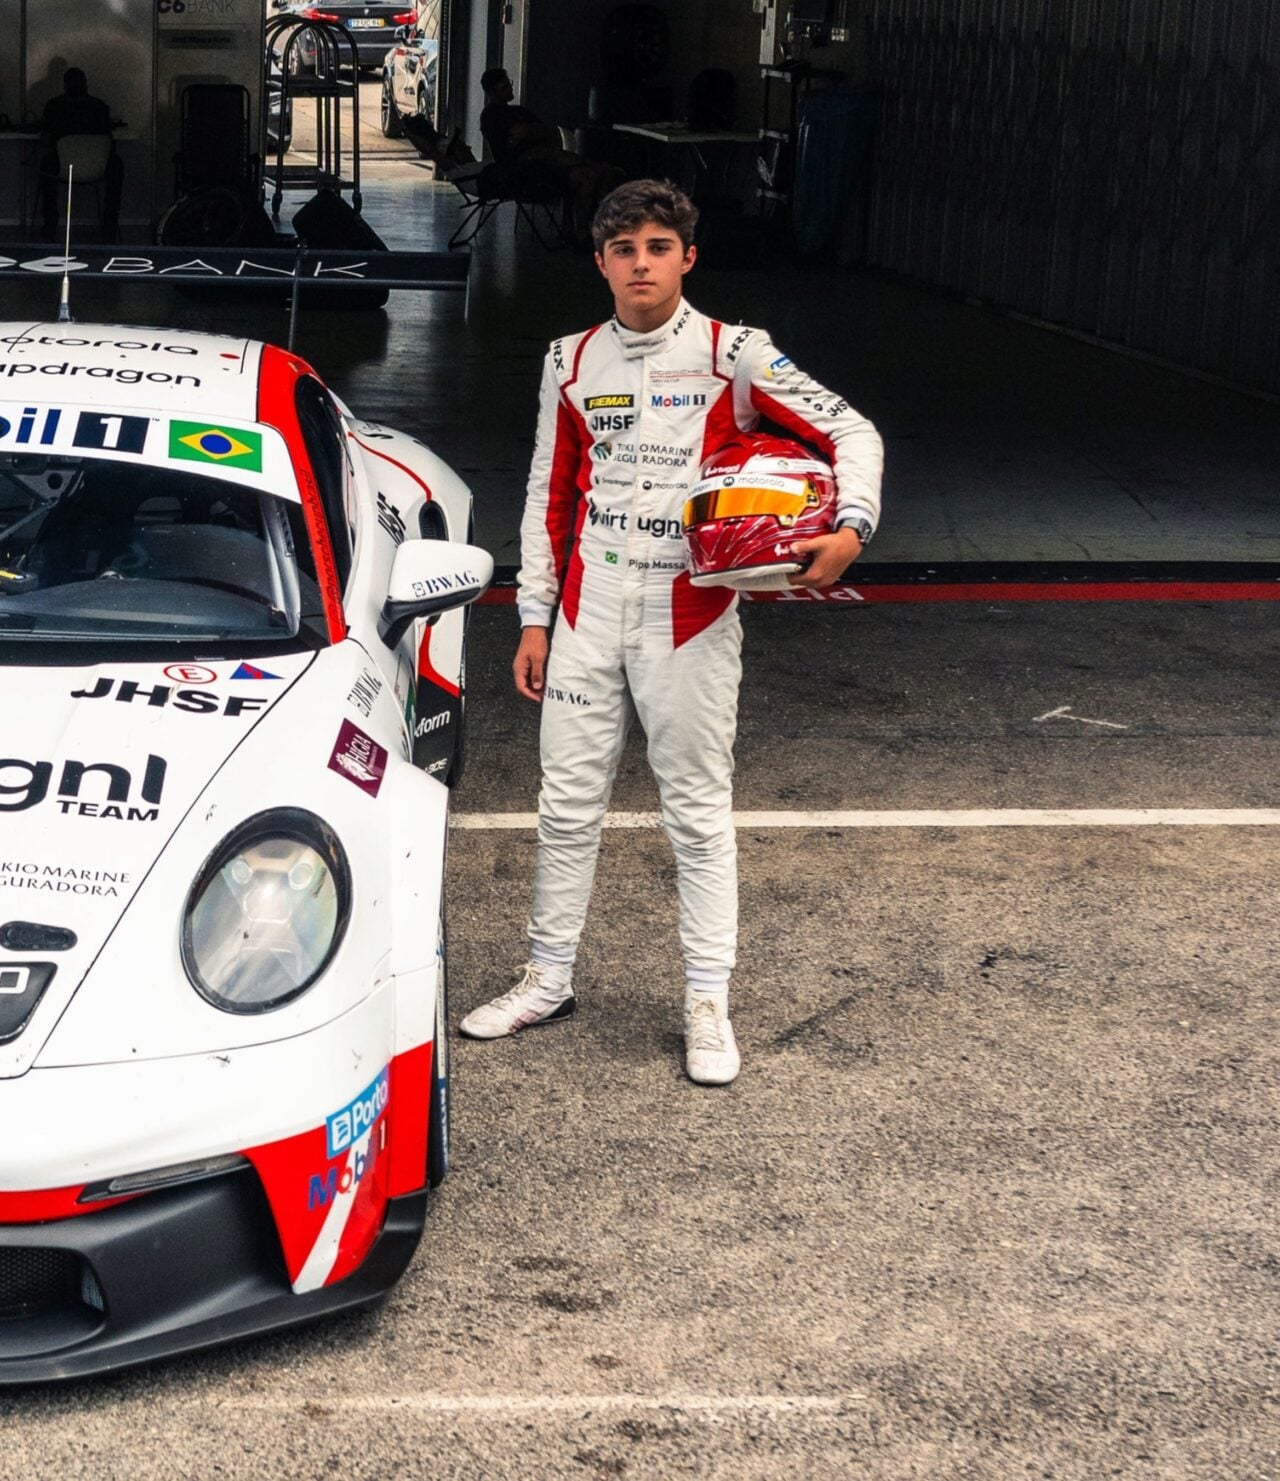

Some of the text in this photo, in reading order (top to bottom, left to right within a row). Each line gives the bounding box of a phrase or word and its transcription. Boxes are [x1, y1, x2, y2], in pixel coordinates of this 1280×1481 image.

[101, 257, 369, 279] BANK
[726, 328, 754, 362] HRX
[651, 394, 690, 407] Mobil
[591, 414, 634, 431] JHSF
[650, 444, 694, 457] MARINE
[737, 477, 786, 489] motorola
[628, 559, 686, 570] Pipe Massa
[70, 677, 268, 717] JHSF
[56, 799, 160, 822] TEAM
[42, 865, 131, 884] MARINE
[352, 1079, 389, 1138] Porto
